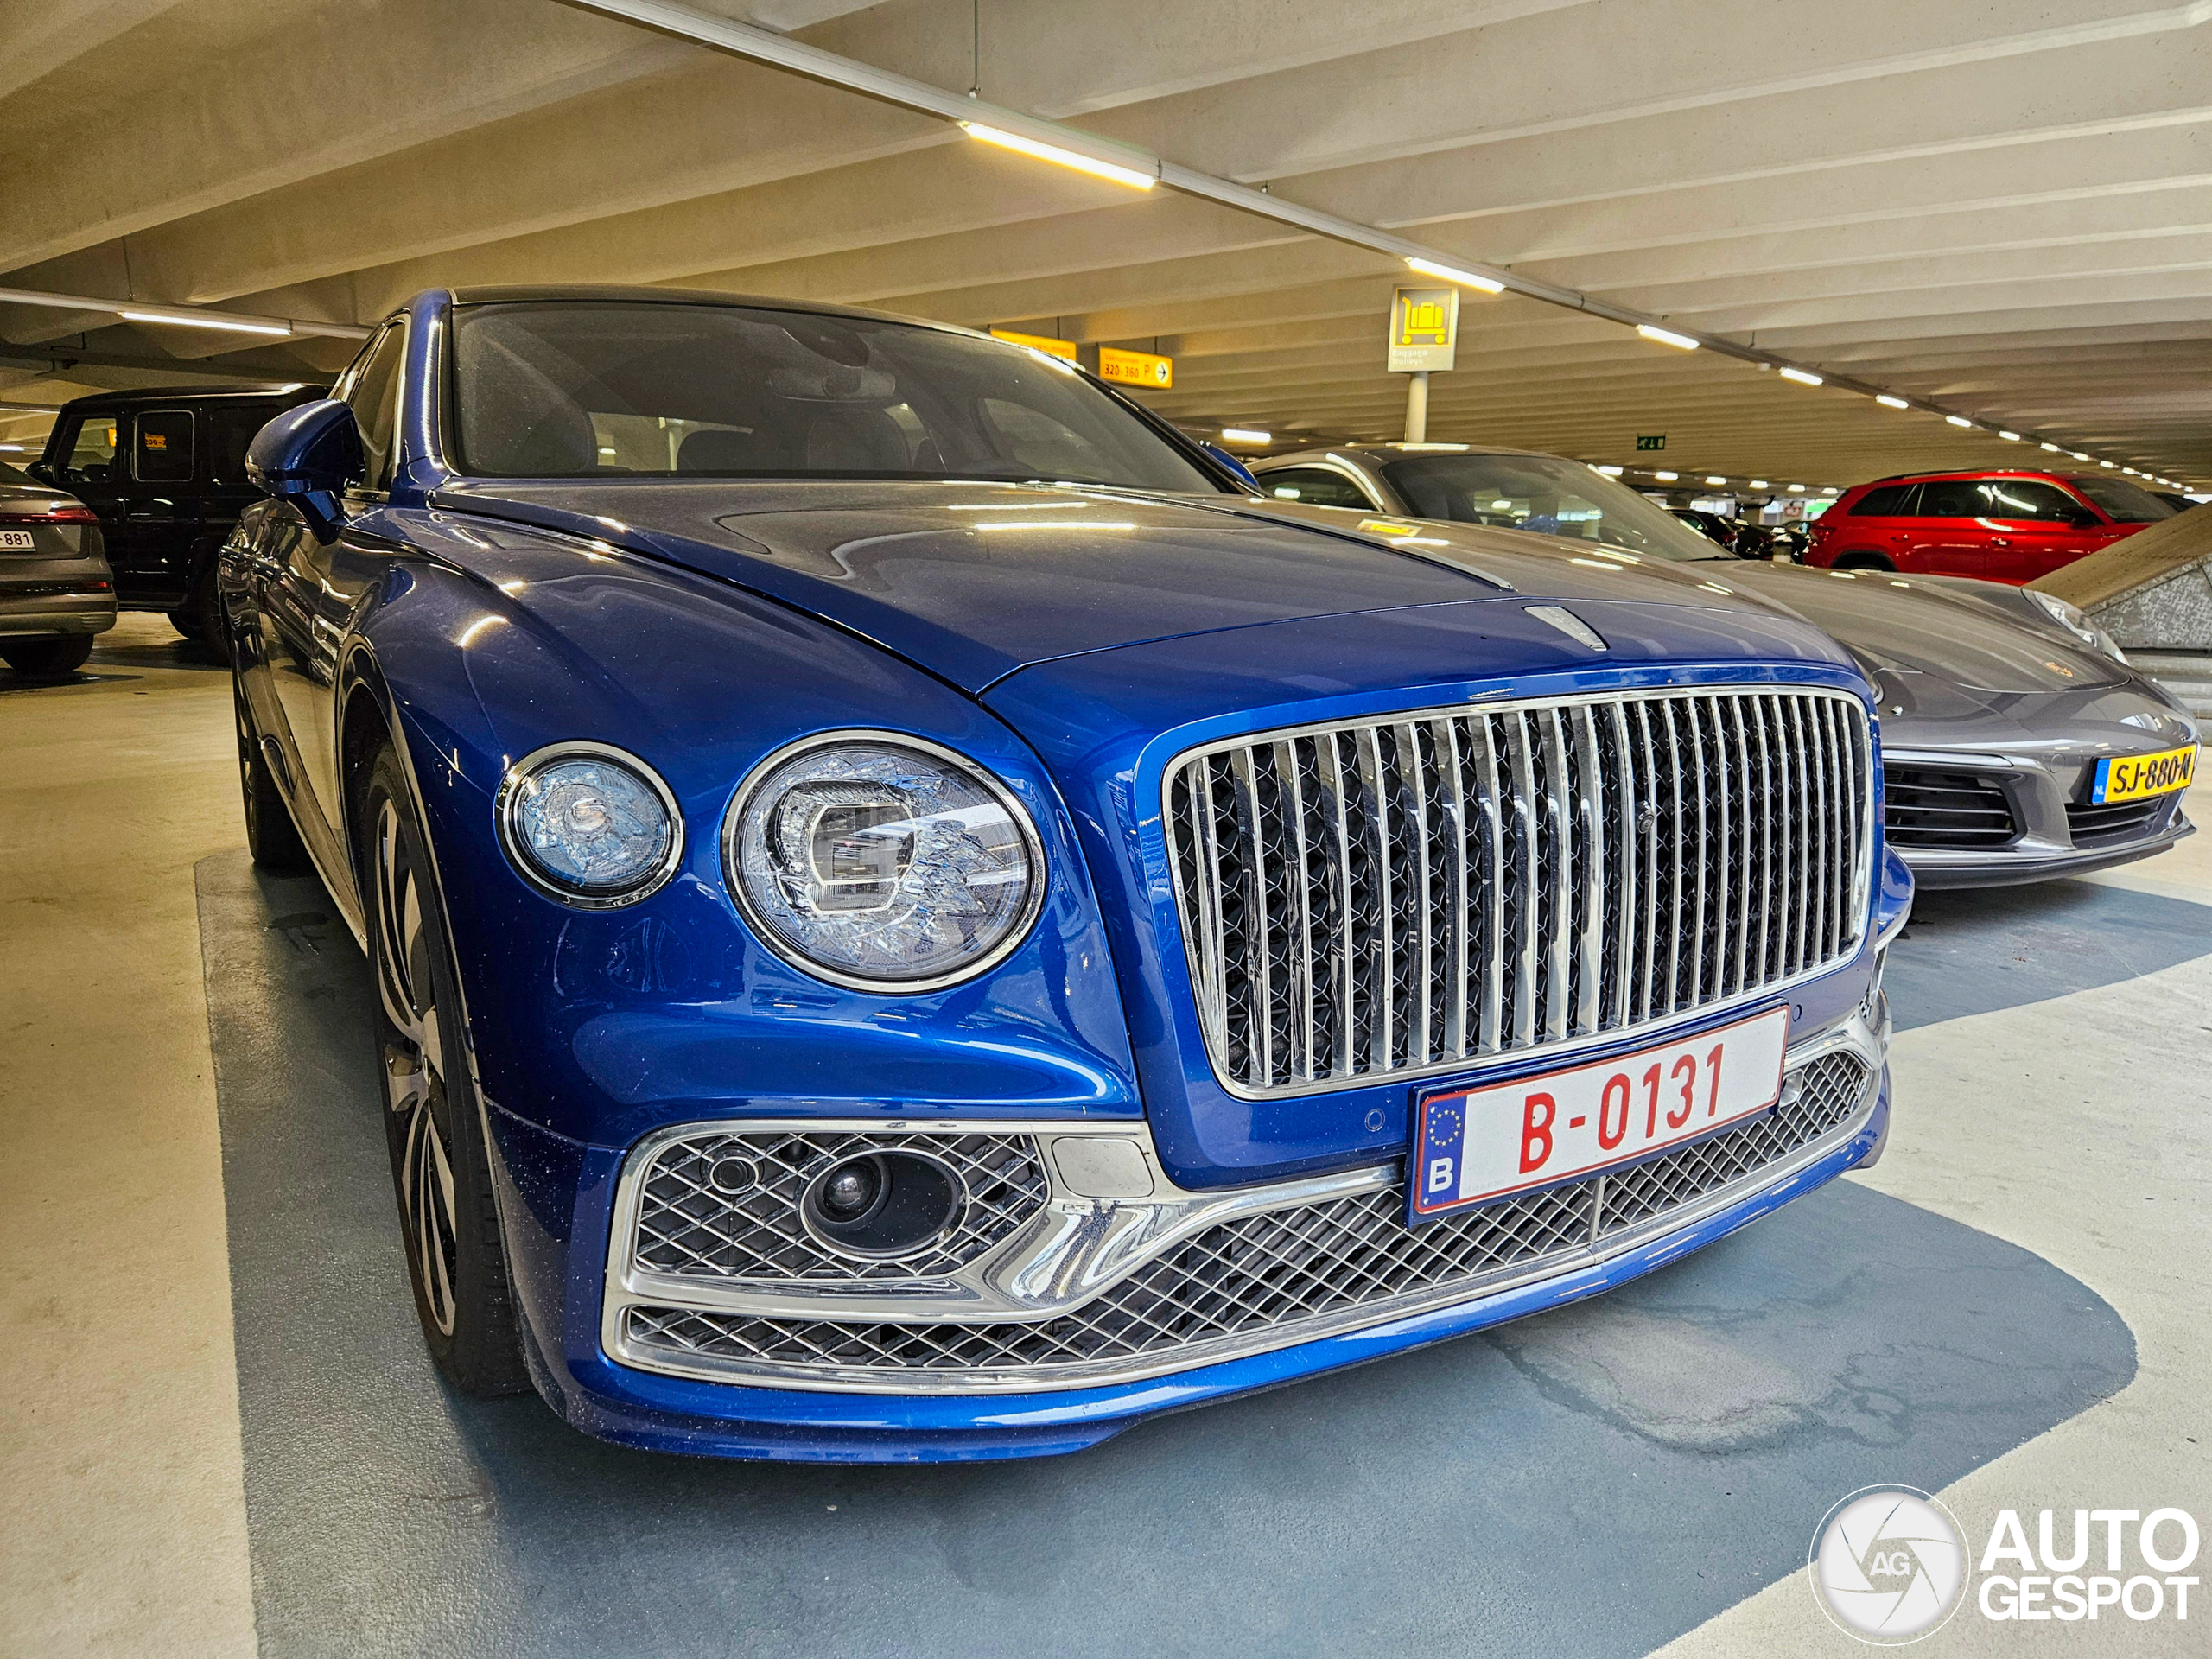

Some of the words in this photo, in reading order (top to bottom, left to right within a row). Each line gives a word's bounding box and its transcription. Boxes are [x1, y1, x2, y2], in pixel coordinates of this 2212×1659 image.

[2093, 785, 2105, 796] NL
[2113, 752, 2192, 793] SJ-880-N
[1518, 1043, 1725, 1175] B-0131
[1428, 1157, 1454, 1193] B
